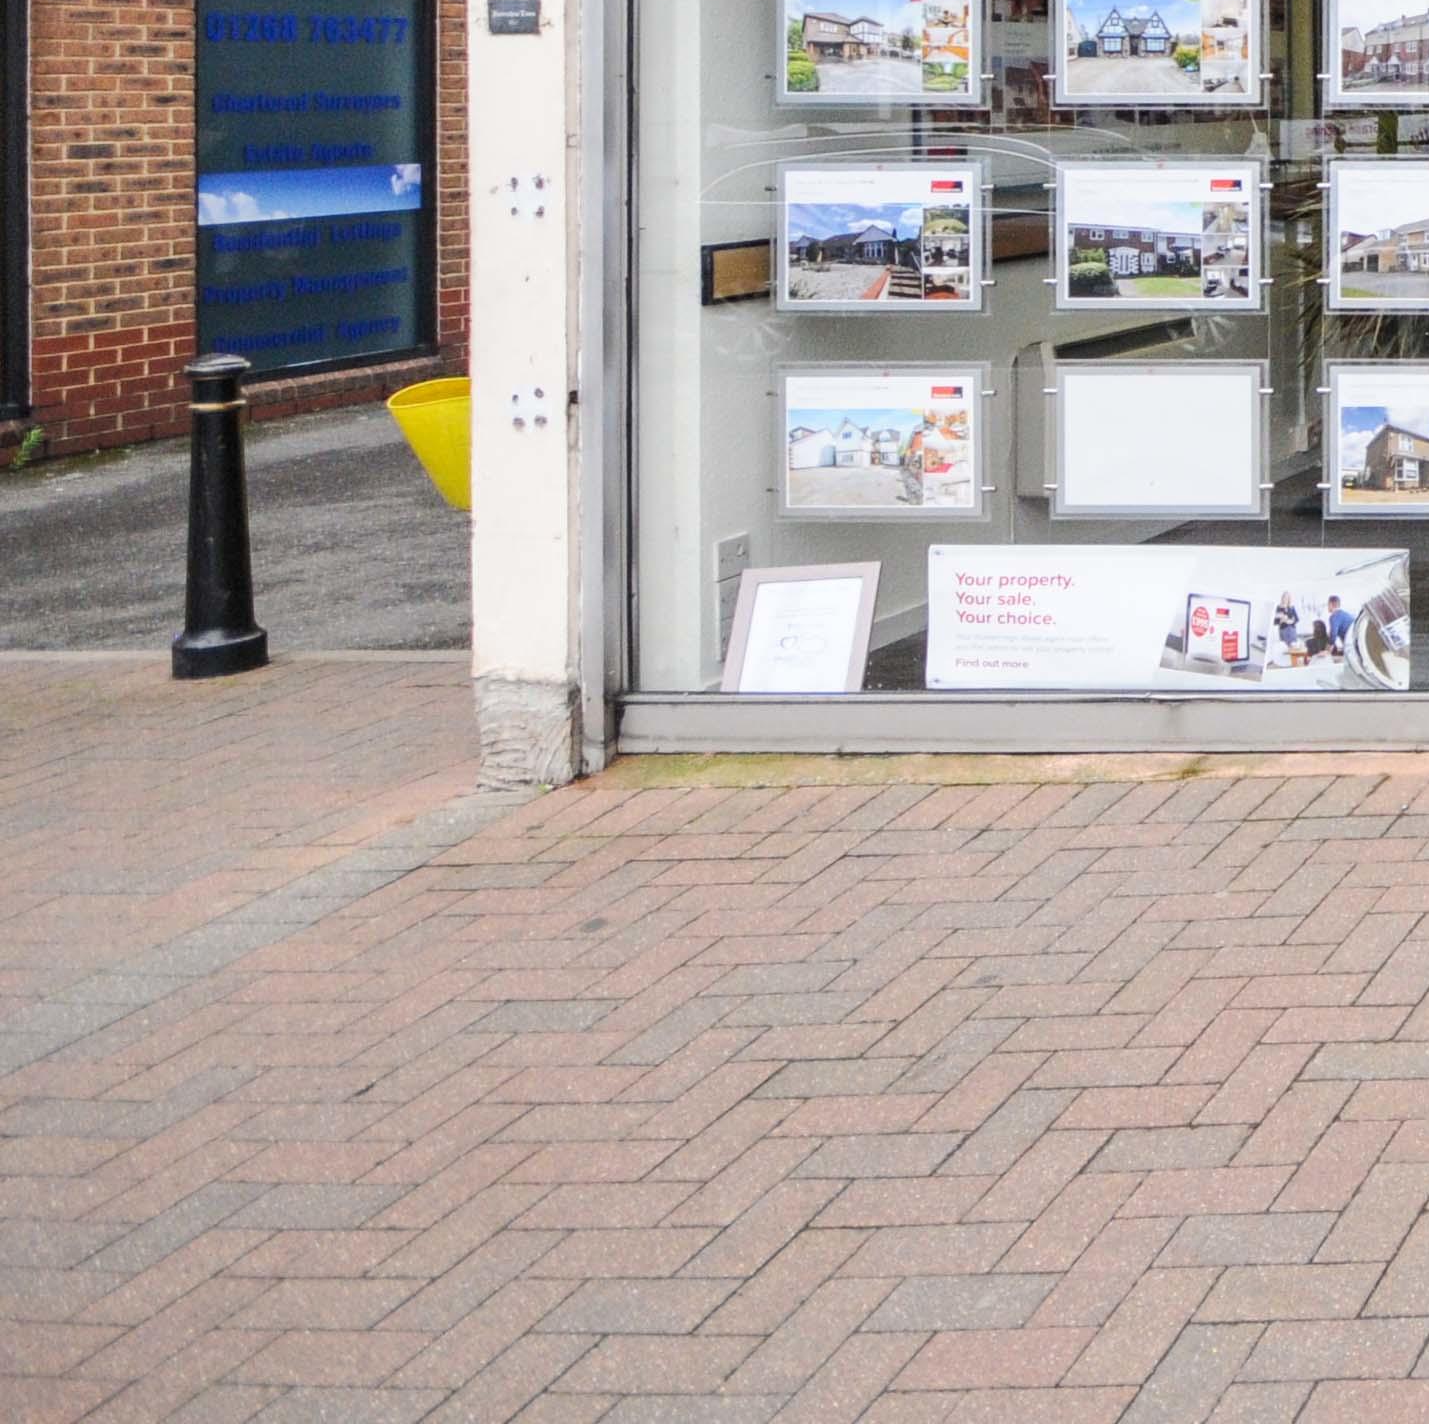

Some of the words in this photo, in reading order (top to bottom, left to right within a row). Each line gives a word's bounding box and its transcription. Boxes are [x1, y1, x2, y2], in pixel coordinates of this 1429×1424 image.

[205, 11, 298, 44] 01268
[313, 90, 402, 114] Surveyors
[955, 572, 992, 587] Your
[998, 573, 1076, 589] property.
[955, 591, 992, 606] Your
[997, 592, 1037, 607] sale.
[955, 610, 992, 625] Your
[997, 611, 1058, 626] choice.
[954, 657, 980, 668] Find
[982, 658, 1000, 668] out
[1001, 660, 1030, 669] more
